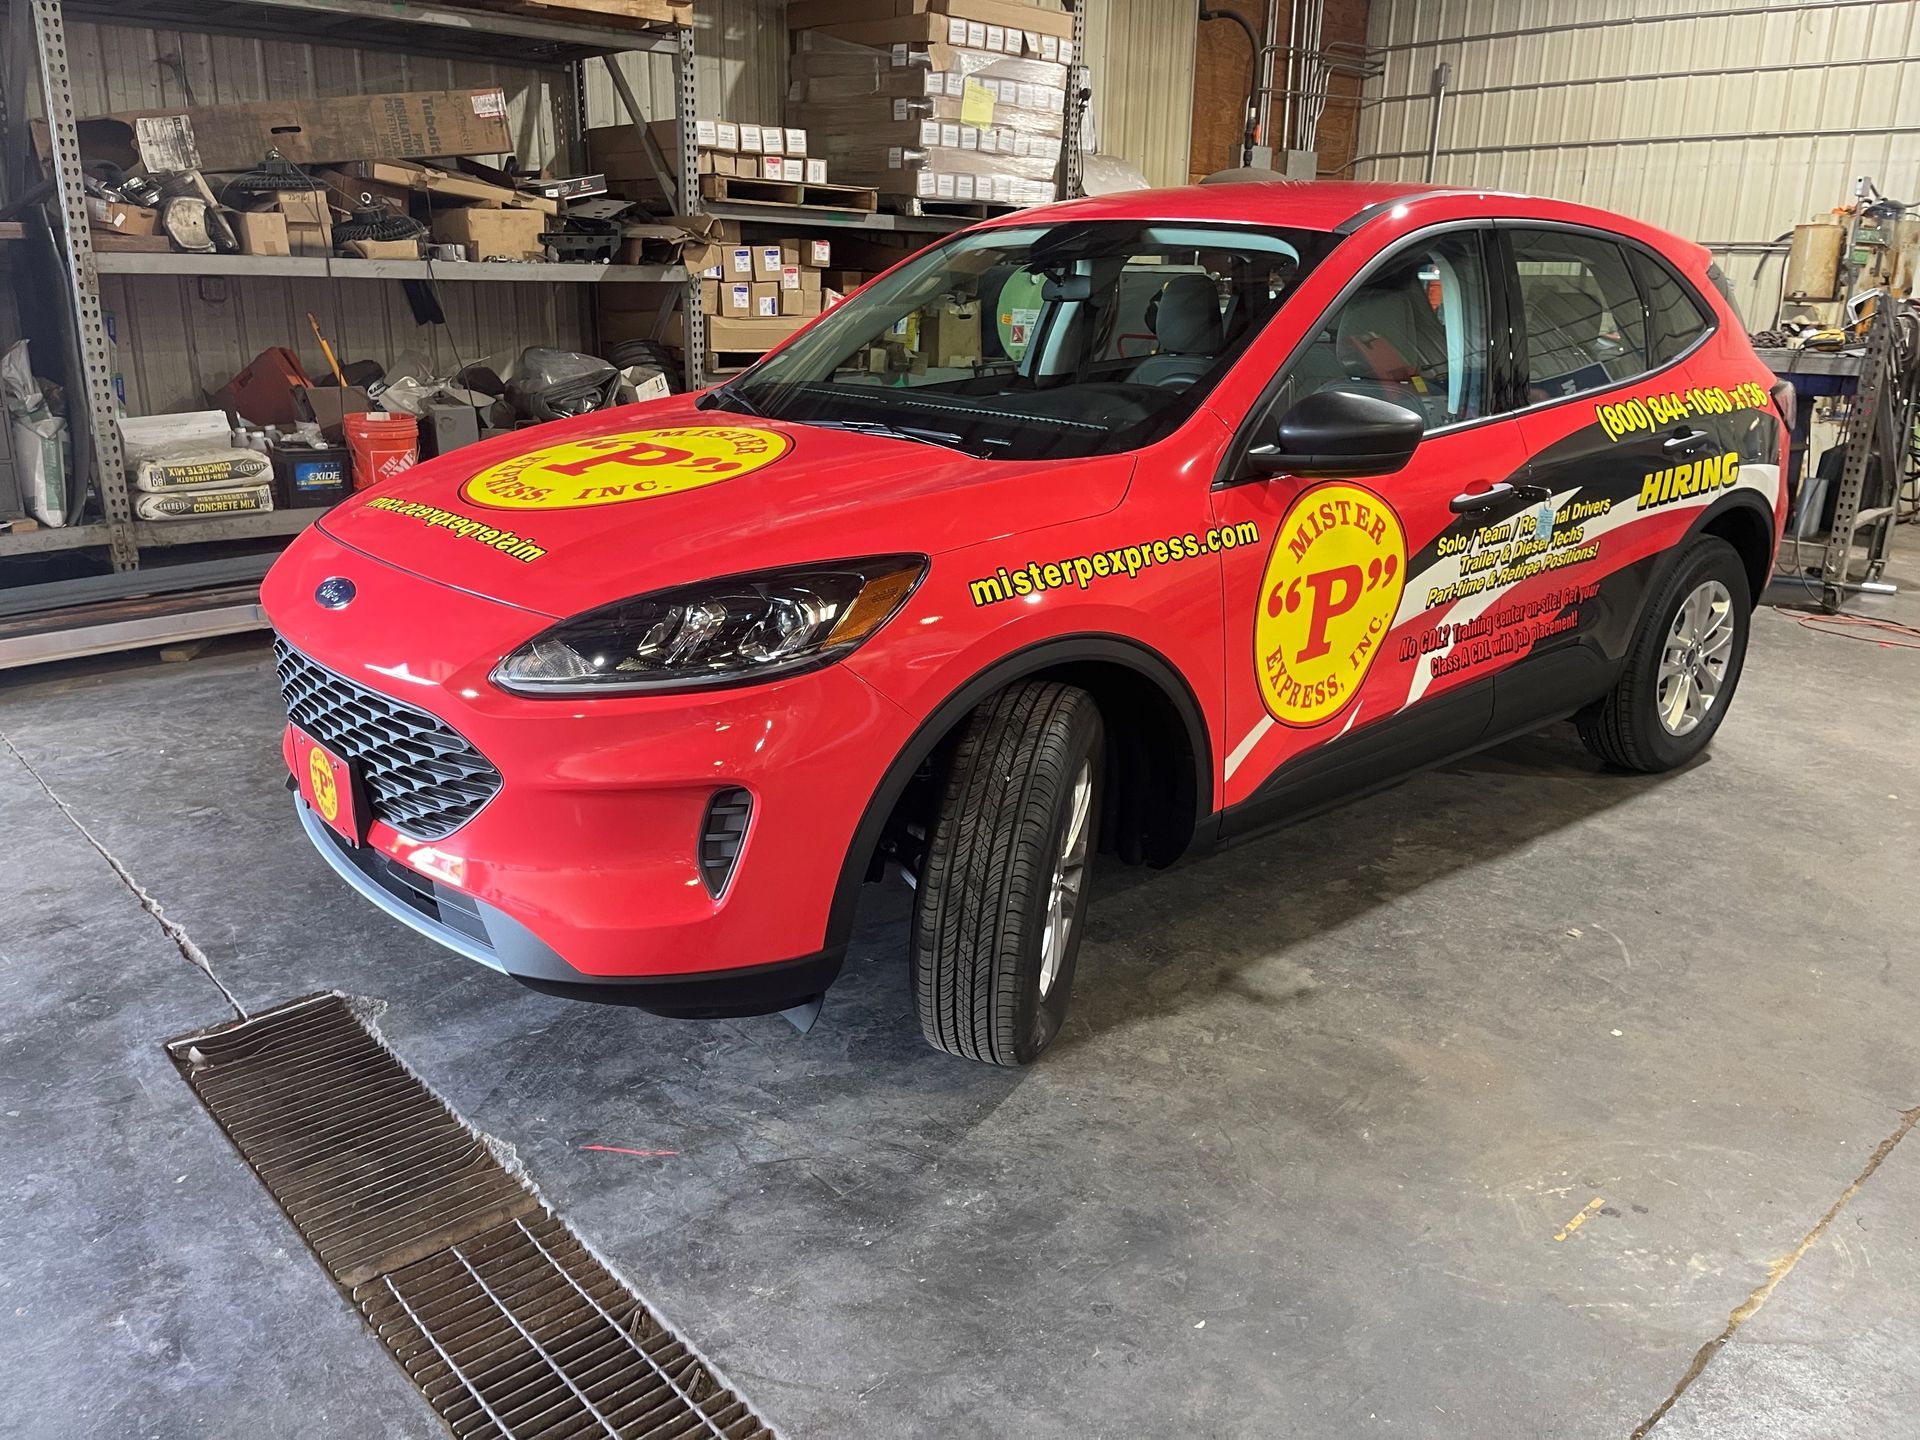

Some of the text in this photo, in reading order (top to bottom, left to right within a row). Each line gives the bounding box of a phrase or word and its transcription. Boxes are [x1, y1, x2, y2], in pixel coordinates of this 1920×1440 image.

[394, 97, 414, 156] INSULATION
[412, 133, 425, 155] PIPE
[421, 96, 442, 154] Tubolit
[651, 428, 769, 455] MISTER
[1594, 382, 1768, 443] (800) 844-1060 x136
[152, 478, 164, 487] 80
[168, 466, 186, 477] MIX
[187, 462, 232, 475] CONCRETE
[308, 471, 340, 481] EXIDE
[378, 455, 399, 476] THE
[485, 456, 556, 503] EXPRESS,
[573, 480, 672, 500] INC.
[1637, 452, 1740, 511] HIRING
[193, 499, 256, 513] CONCRETE MIX
[1288, 500, 1387, 564] MISTER
[1437, 535, 1467, 557] Solo
[1477, 524, 1511, 547] Team
[1511, 516, 1521, 540] /
[1572, 498, 1612, 521] Drivers
[969, 520, 1260, 606] misterpexpress.com
[1426, 542, 1600, 609] Part-time & Retiree Positions!
[1459, 551, 1500, 576] Trailer
[1500, 544, 1511, 563] &
[1551, 527, 1584, 551] Techs
[1349, 612, 1389, 671] INC.
[1400, 584, 1601, 661] No CDL? Training center on-site! Get your
[1430, 609, 1579, 679] Class A CDL with job placement!
[1266, 645, 1345, 709] EXPRESS,
